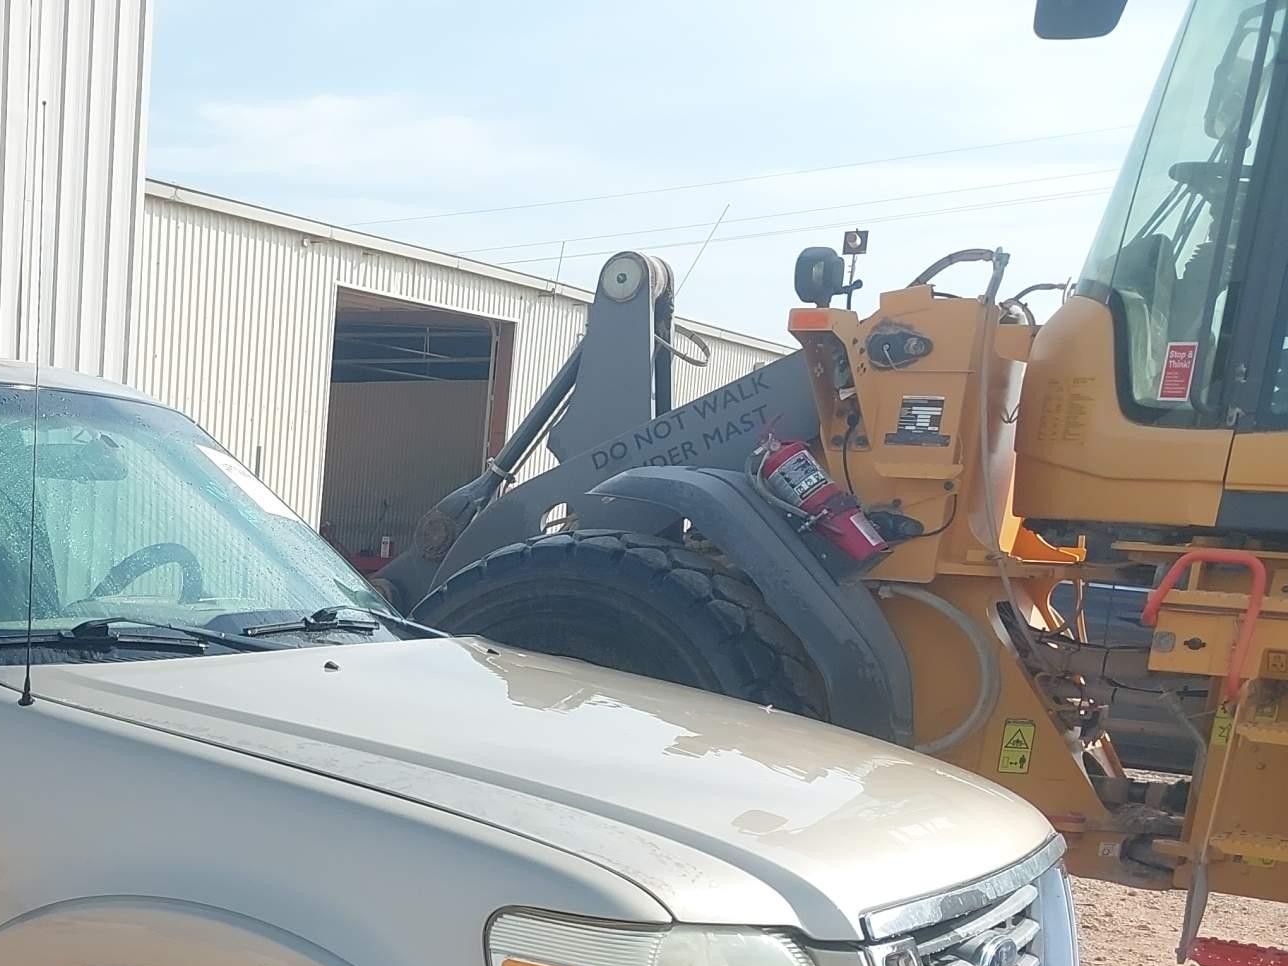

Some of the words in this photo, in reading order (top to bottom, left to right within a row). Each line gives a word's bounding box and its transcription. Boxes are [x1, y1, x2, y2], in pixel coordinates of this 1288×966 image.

[1168, 360, 1191, 368] Think!
[1169, 350, 1187, 360] Stop
[591, 441, 628, 470] DO
[633, 410, 687, 450] NOT
[692, 372, 772, 420] WALK
[642, 440, 699, 466] DER
[702, 404, 768, 450] MAST
